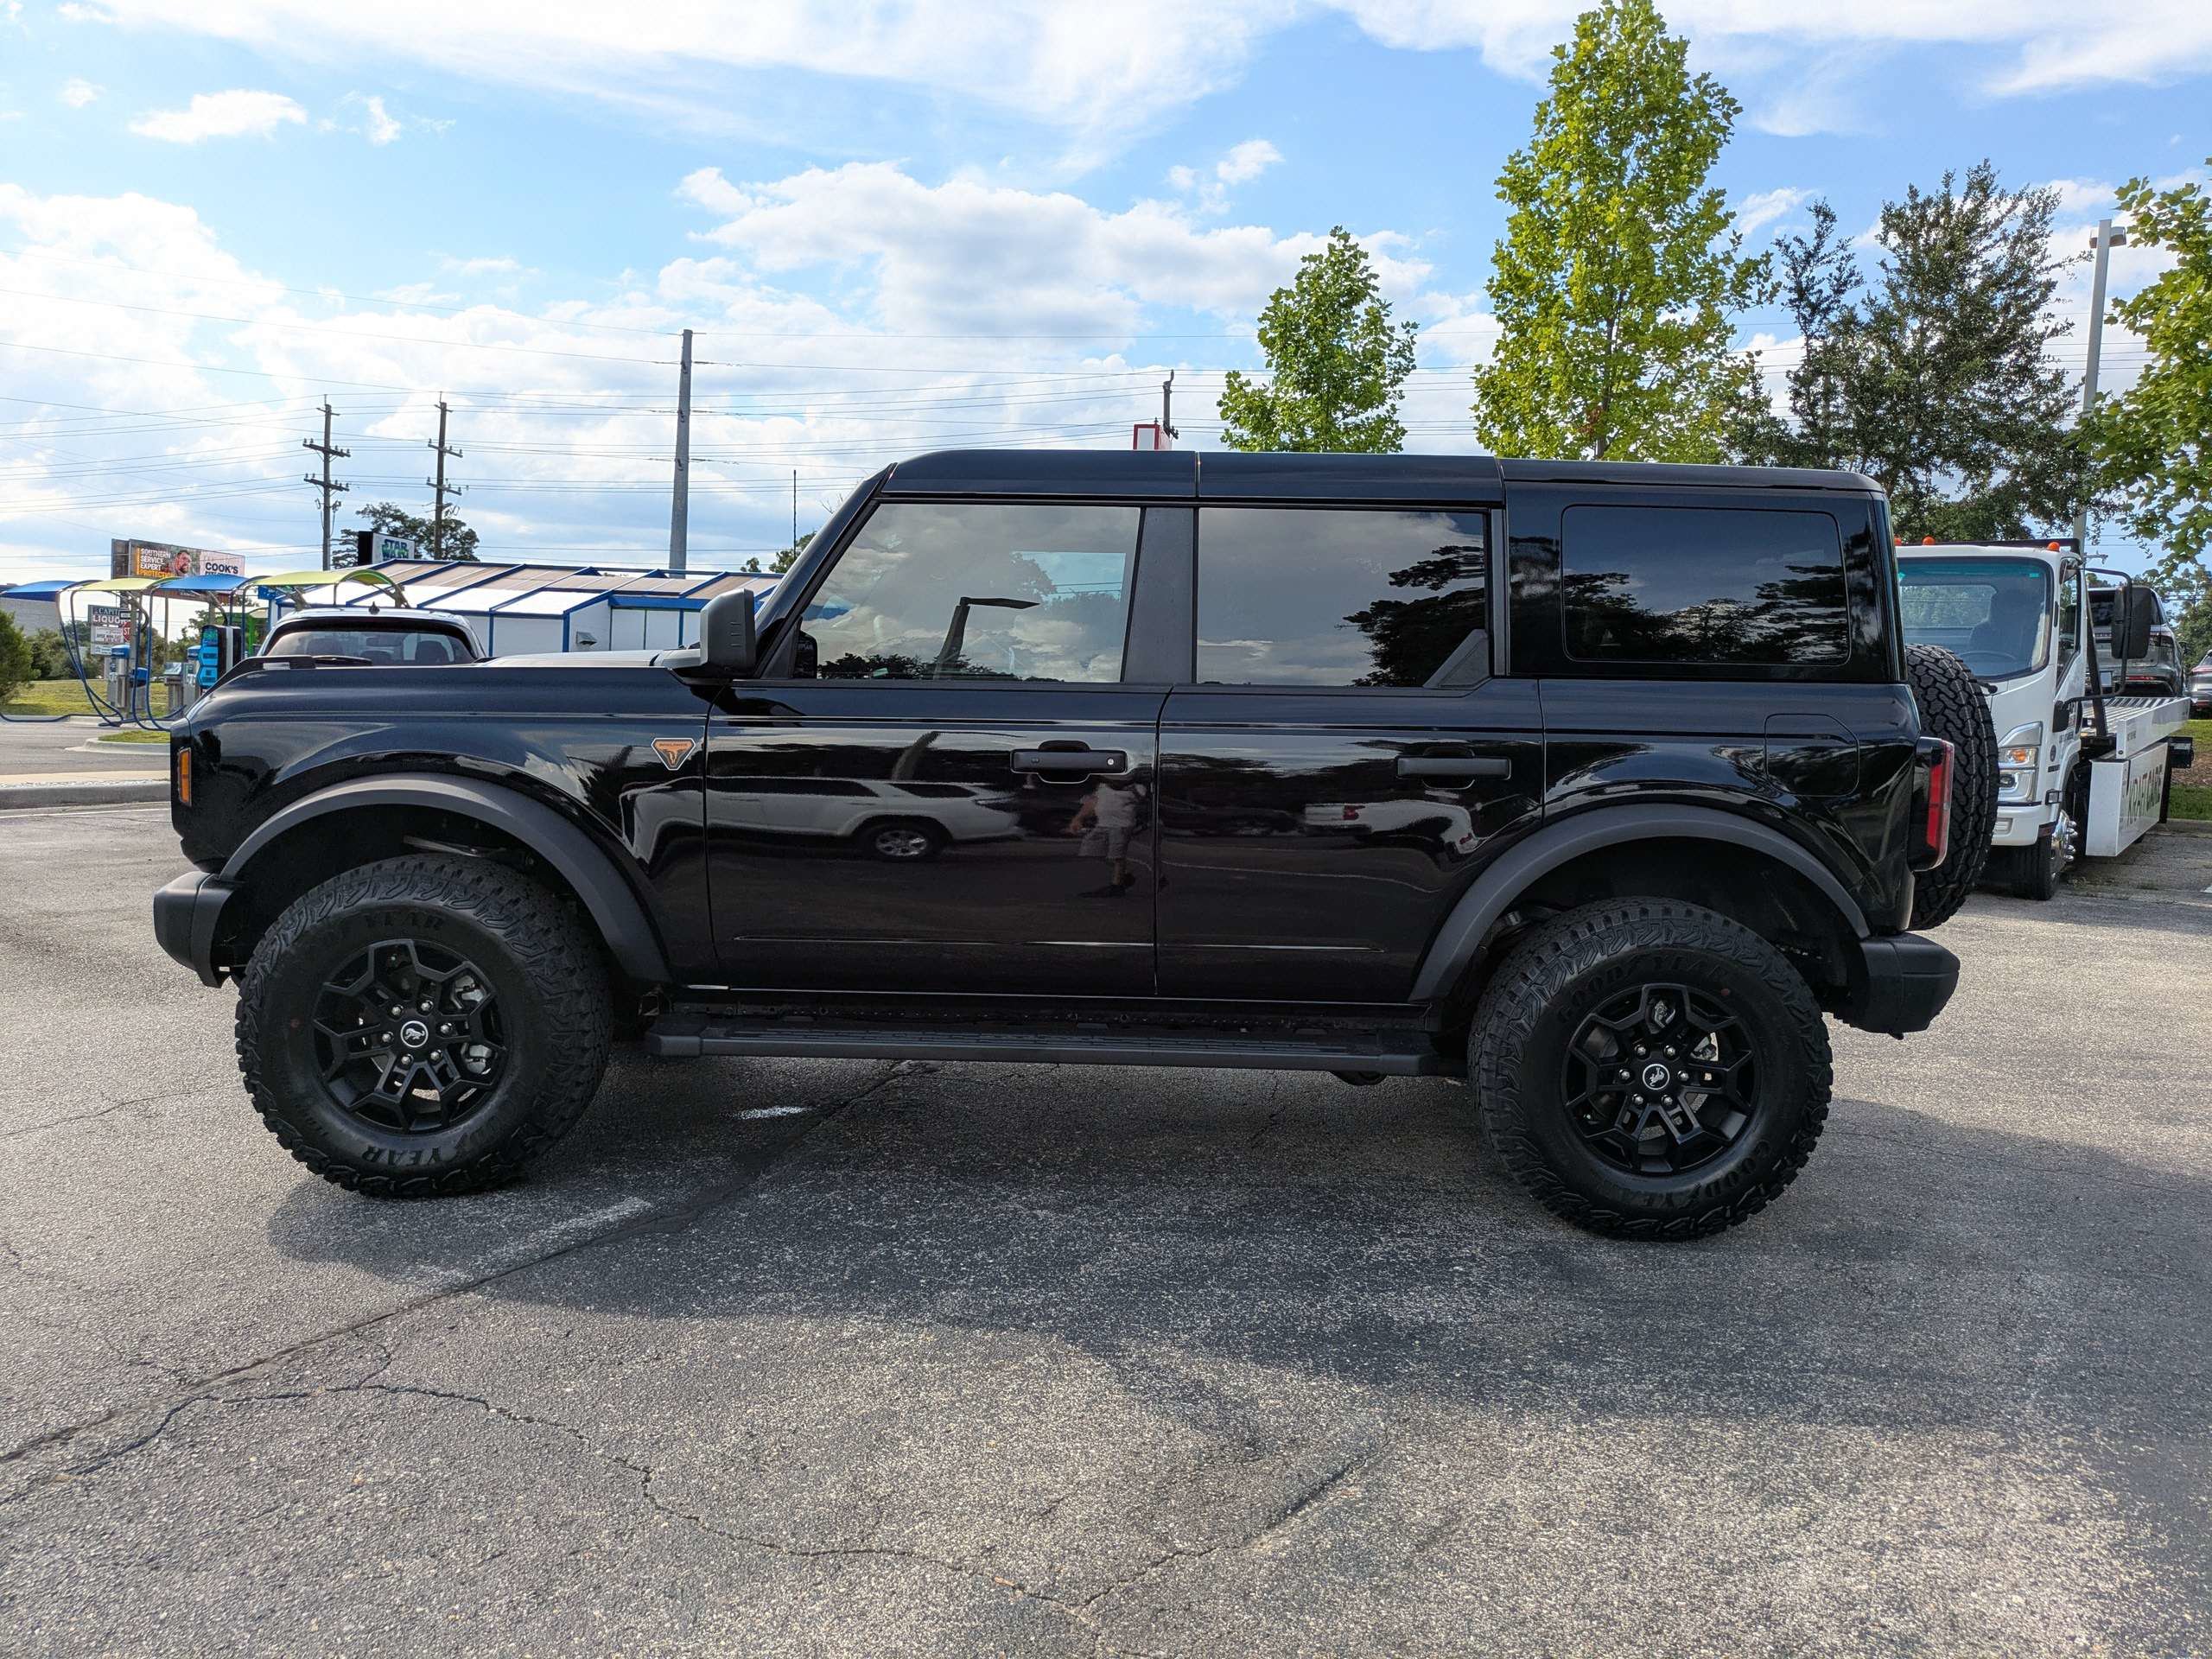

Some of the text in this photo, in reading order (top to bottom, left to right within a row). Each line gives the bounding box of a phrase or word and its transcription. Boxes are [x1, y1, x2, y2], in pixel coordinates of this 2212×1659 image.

[384, 539, 409, 551] STAR
[140, 548, 171, 559] SOUTHERN
[140, 555, 164, 564] SERVICE
[140, 562, 162, 570] EXPERT
[205, 562, 238, 575] COOK'S
[92, 614, 121, 624] LIQUO
